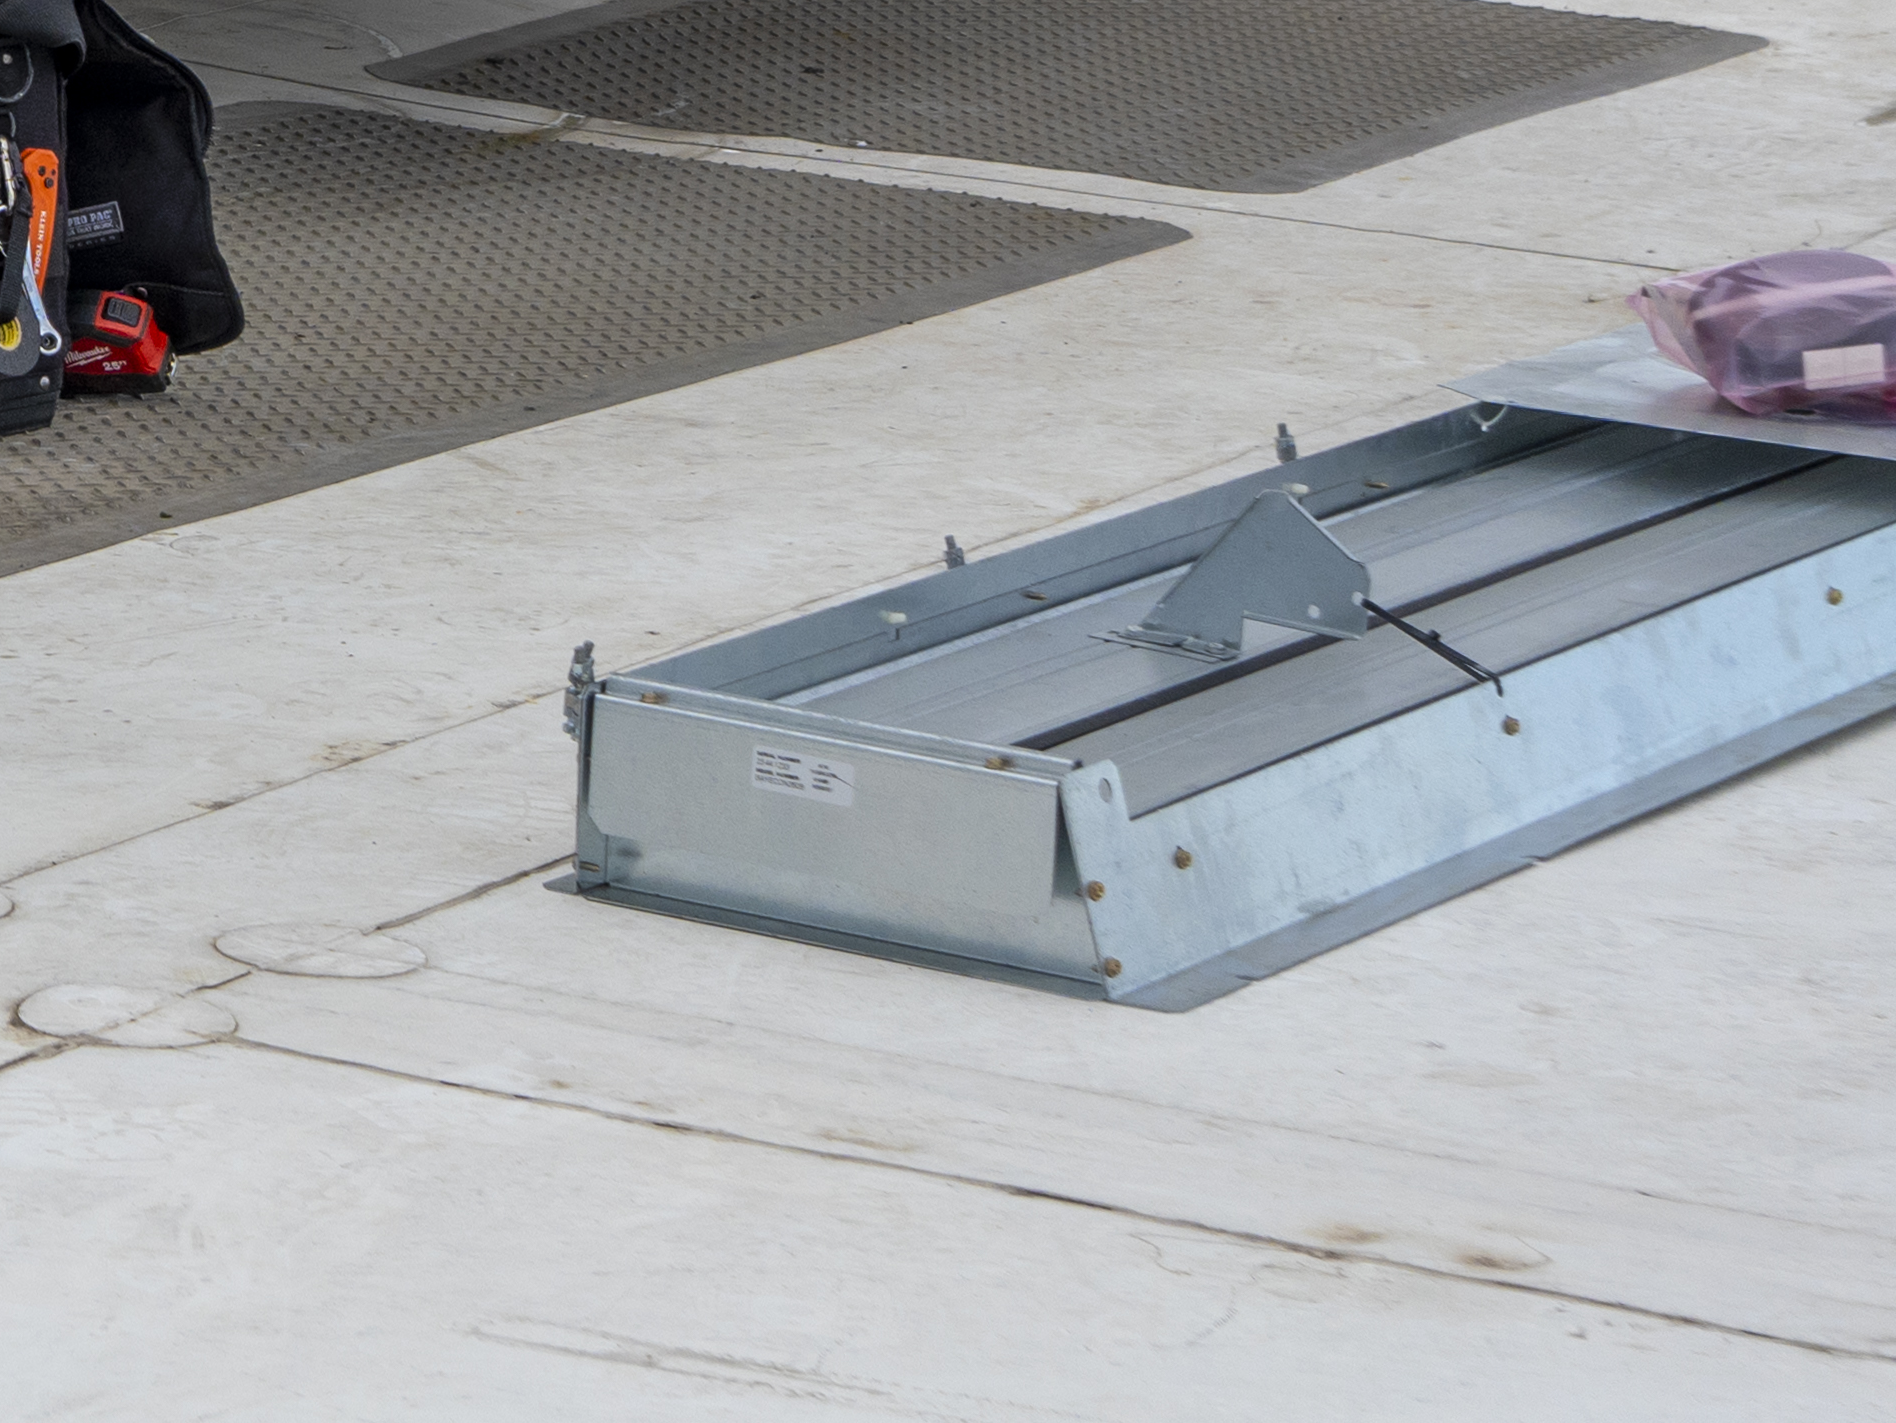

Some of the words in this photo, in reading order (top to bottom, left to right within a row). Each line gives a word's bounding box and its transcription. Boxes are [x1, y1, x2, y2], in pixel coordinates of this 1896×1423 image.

[37, 210, 47, 241] KLEIN
[89, 210, 111, 222] PAC
[34, 244, 43, 275] TOOLS
